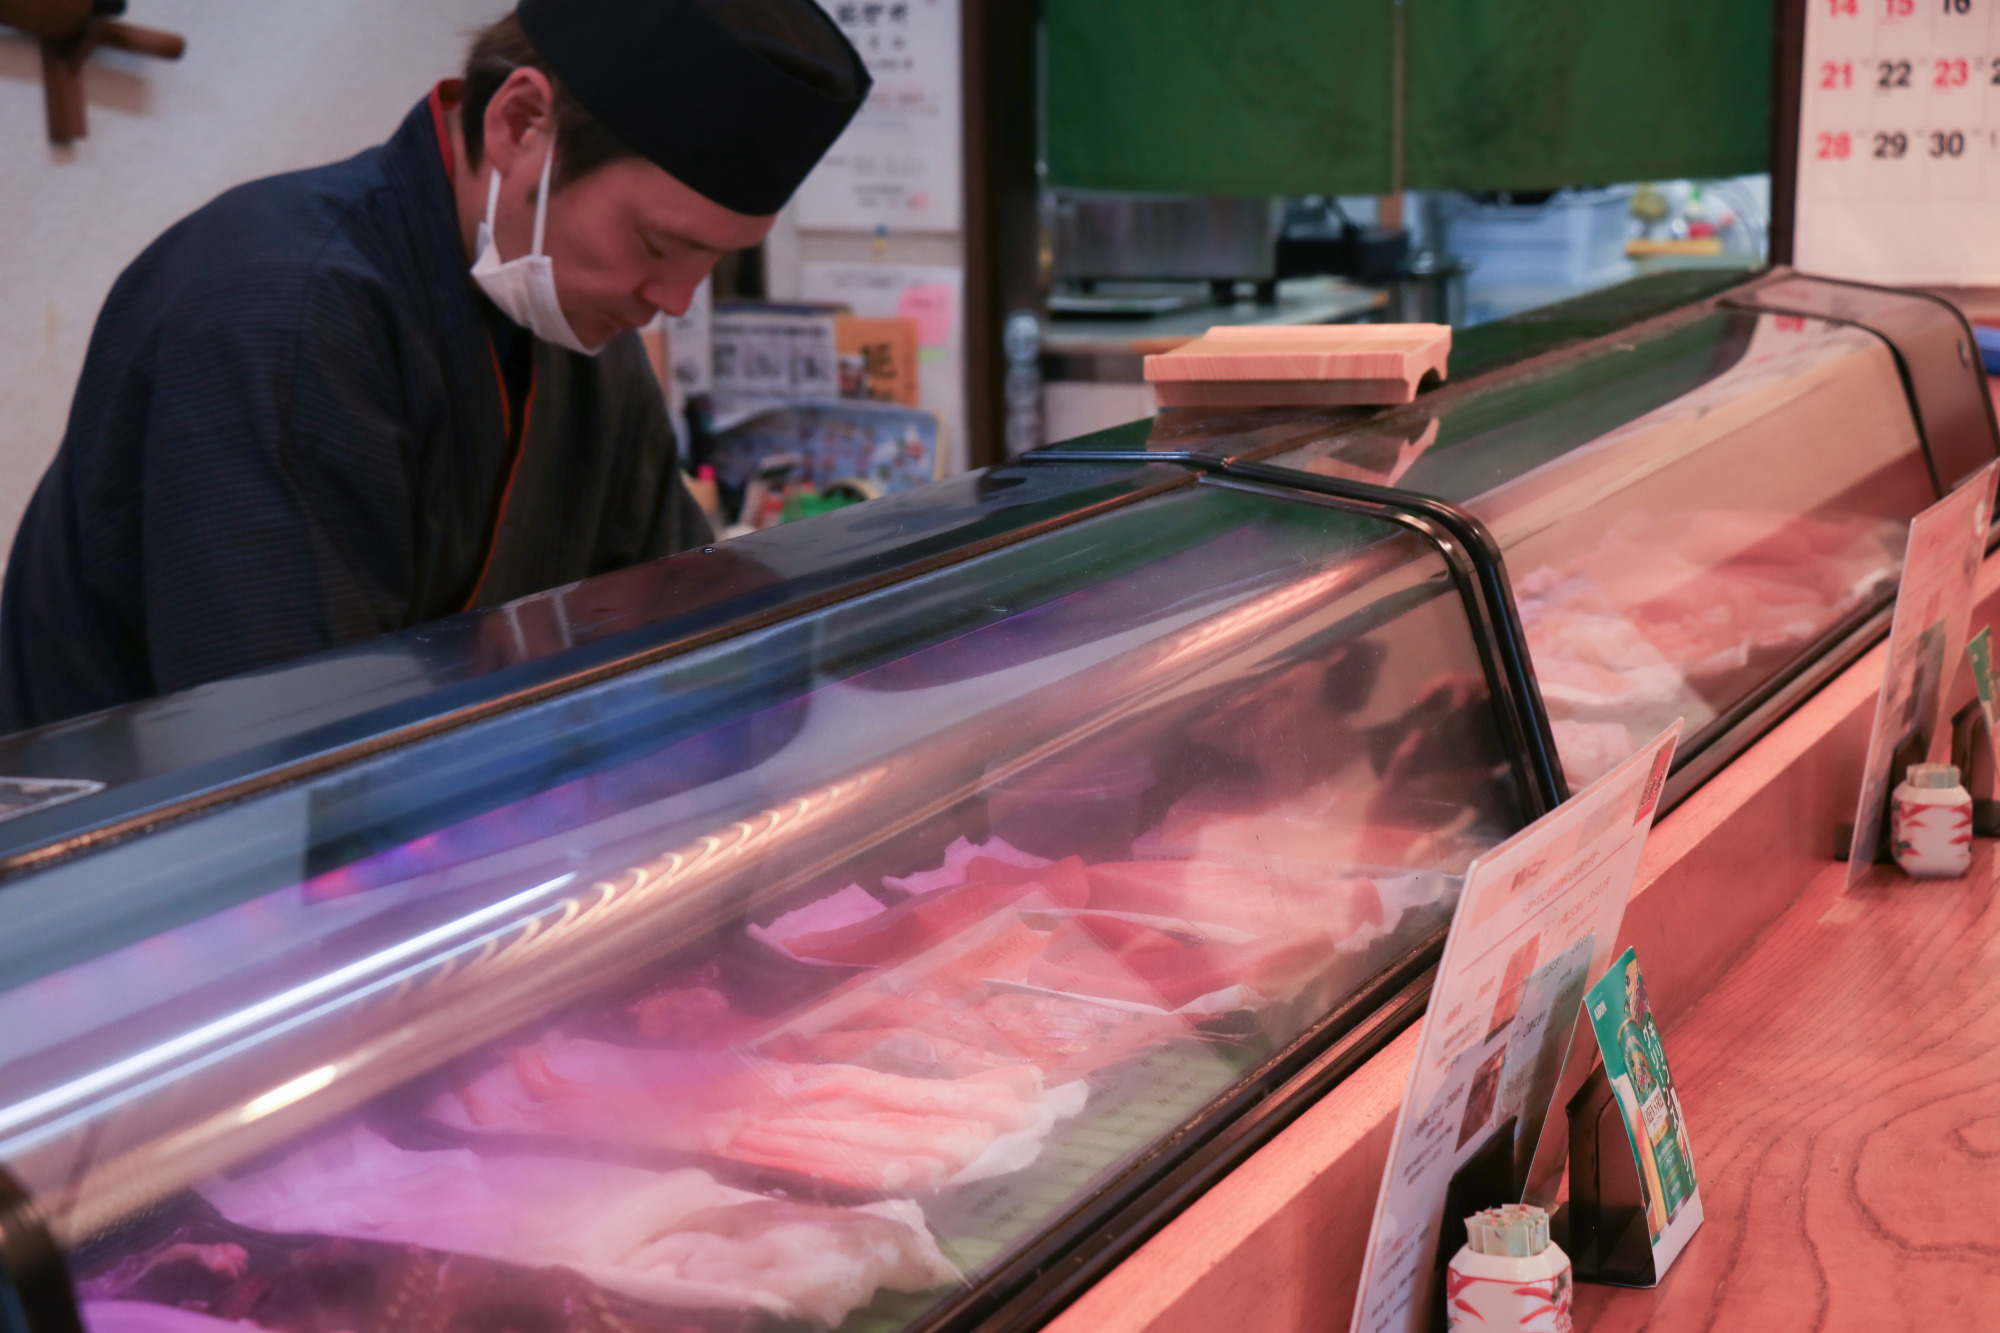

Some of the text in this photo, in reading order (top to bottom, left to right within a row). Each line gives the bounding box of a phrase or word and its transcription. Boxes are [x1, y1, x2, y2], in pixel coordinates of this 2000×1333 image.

[1821, 61, 1852, 89] 21
[1878, 60, 1911, 88] 22
[1934, 58, 1968, 87] 23
[1817, 132, 1851, 159] 28
[1874, 131, 1907, 158] 29
[1930, 130, 1964, 157] 30
